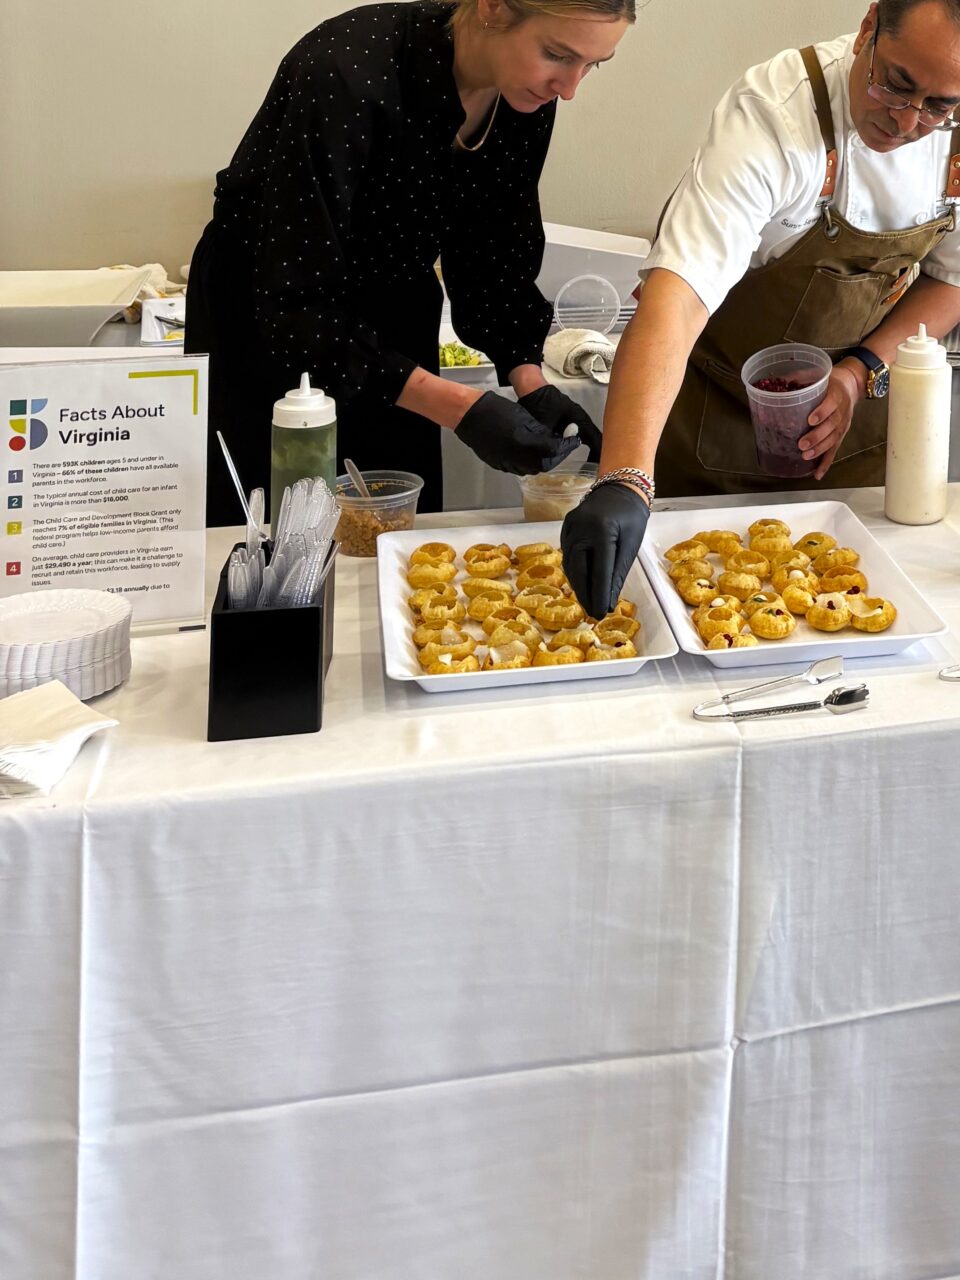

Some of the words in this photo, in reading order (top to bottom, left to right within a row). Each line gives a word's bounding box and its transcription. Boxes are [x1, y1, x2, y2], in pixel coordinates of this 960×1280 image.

[59, 408, 107, 422] Facts
[111, 404, 165, 419] About
[58, 426, 130, 447] Virginia
[13, 471, 17, 480] 1
[11, 497, 18, 506] 2
[40, 500, 63, 508] Virginia
[147, 553, 175, 561] challenge
[9, 564, 17, 573] 4
